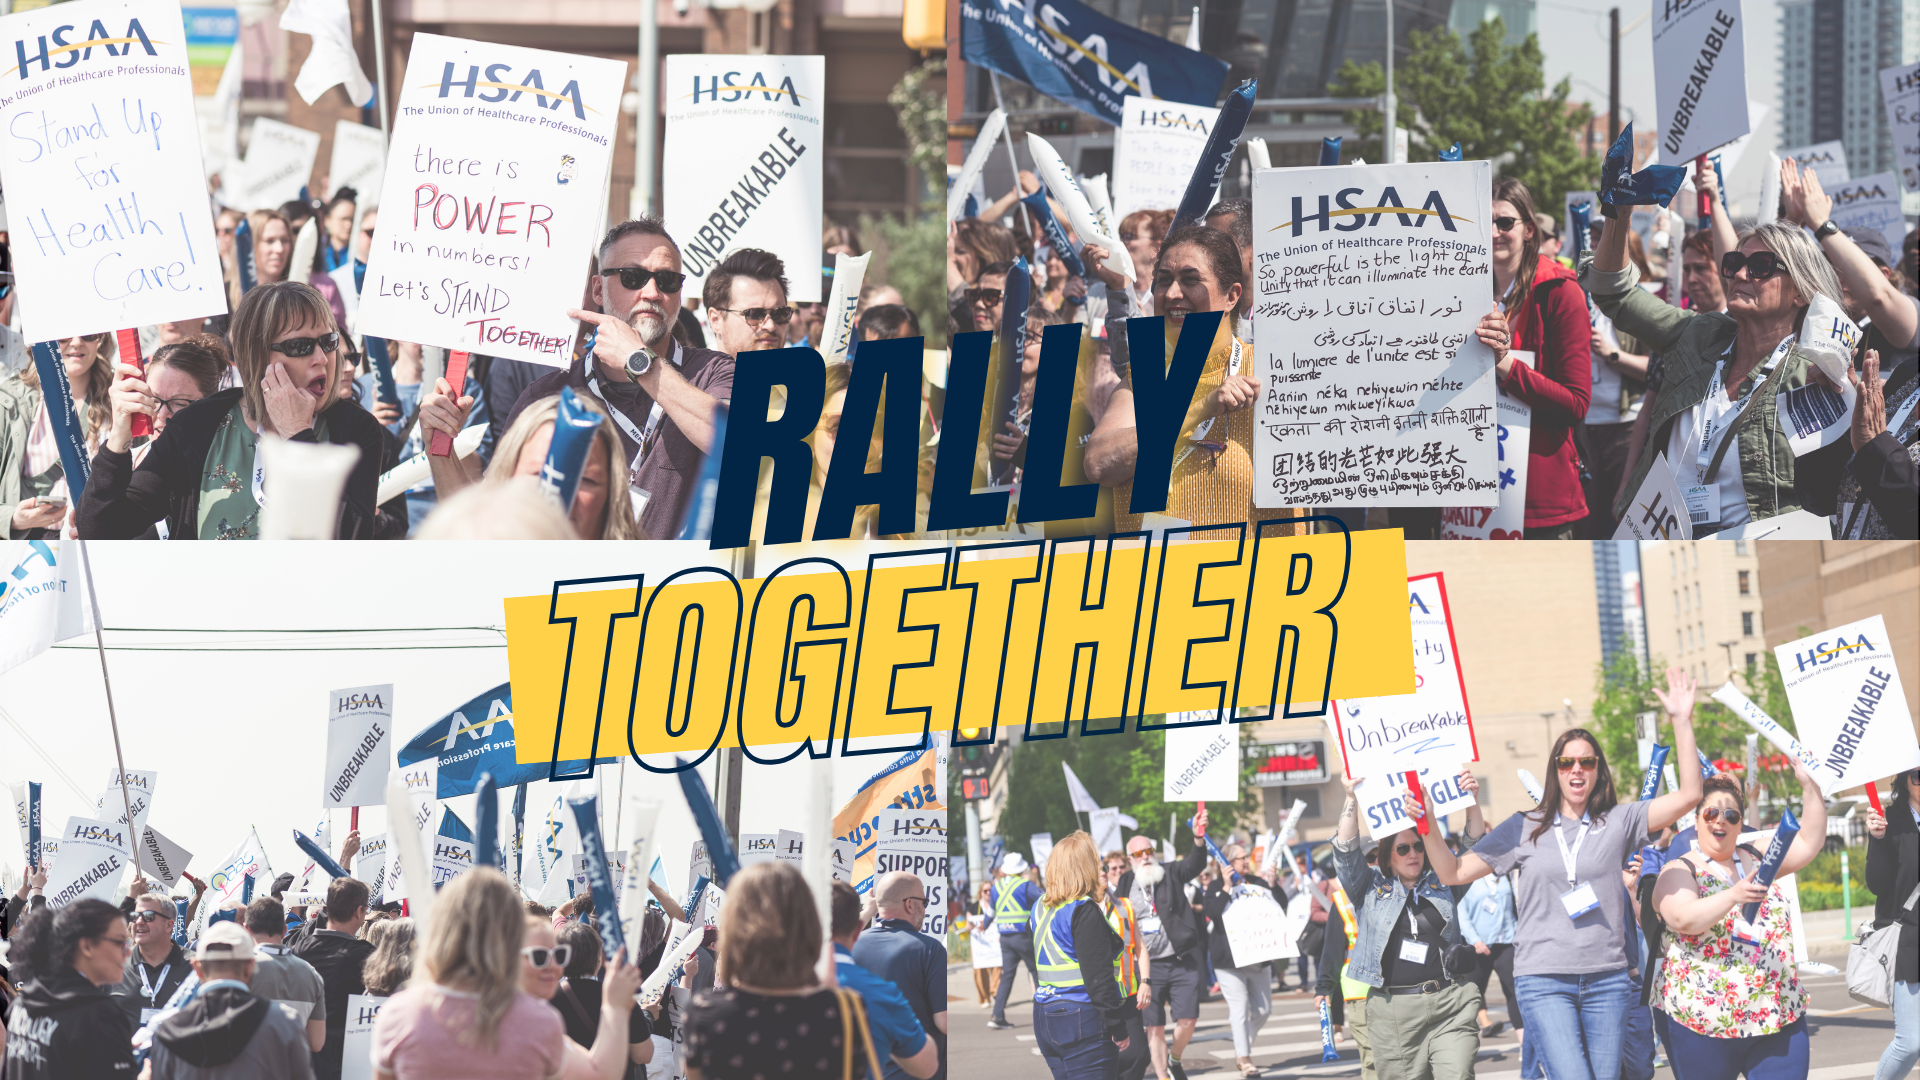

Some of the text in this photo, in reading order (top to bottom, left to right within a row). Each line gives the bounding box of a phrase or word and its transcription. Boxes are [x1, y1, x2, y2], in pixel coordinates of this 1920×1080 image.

[15, 18, 158, 80] HSAA
[15, 64, 186, 100] Union of Healthcare Professionals
[438, 61, 587, 121] HSAA
[693, 71, 801, 107] HSAA
[1664, 9, 1735, 155] UNBREAKABLE
[10, 98, 162, 163] Stand Up
[403, 105, 608, 147] The Union of Healthcare Professionals
[670, 107, 820, 125] The Union of Healthcare Professionals
[1140, 110, 1208, 135] HSAA
[413, 144, 481, 176] there
[495, 159, 519, 179] is
[414, 182, 554, 248] POWER
[682, 127, 807, 278] UNBREAKABLE
[1291, 186, 1458, 237] HSAA
[27, 191, 164, 257] Health
[93, 212, 203, 300] Care!
[393, 234, 531, 274] in numbers!
[1257, 236, 1487, 264] The Union of Healthcare Professionals
[1258, 249, 1471, 281] So powerful is the light of
[379, 275, 510, 319] Let's STAND
[1260, 275, 1292, 294] Unity
[1292, 277, 1320, 289] that
[1323, 274, 1336, 287] it
[1338, 274, 1361, 285] can
[1367, 267, 1427, 283] illuminate
[1433, 264, 1455, 276] the
[835, 295, 859, 354] HSAA
[1231, 342, 1241, 367] MEMBER
[1270, 353, 1283, 370] la
[1346, 349, 1360, 365] de
[1414, 347, 1440, 361] est
[1445, 348, 1457, 360] si
[1271, 367, 1322, 387] puissante
[1496, 402, 1528, 416] ssionals
[1413, 638, 1446, 665] ity
[1795, 633, 1875, 673] HSAA
[1786, 680, 1798, 689] The
[1799, 671, 1815, 683] Union
[1822, 659, 1853, 673] Healthcare
[1854, 653, 1892, 663] Professionals
[338, 693, 384, 713] HSAA
[329, 722, 385, 803] UNBREAKABLE
[1170, 733, 1231, 796] UNBREAKABLE
[1642, 761, 1659, 798] HSAA
[17, 801, 28, 829] HSAA
[32, 798, 41, 828] HSAA
[893, 817, 947, 836] HSA
[42, 842, 58, 853] HSA
[74, 825, 123, 847] HSAA
[435, 843, 472, 864] HSA
[748, 838, 776, 850] HSA
[143, 830, 174, 881] UNBREAKABLE
[47, 855, 121, 909] UNBREAKABLE
